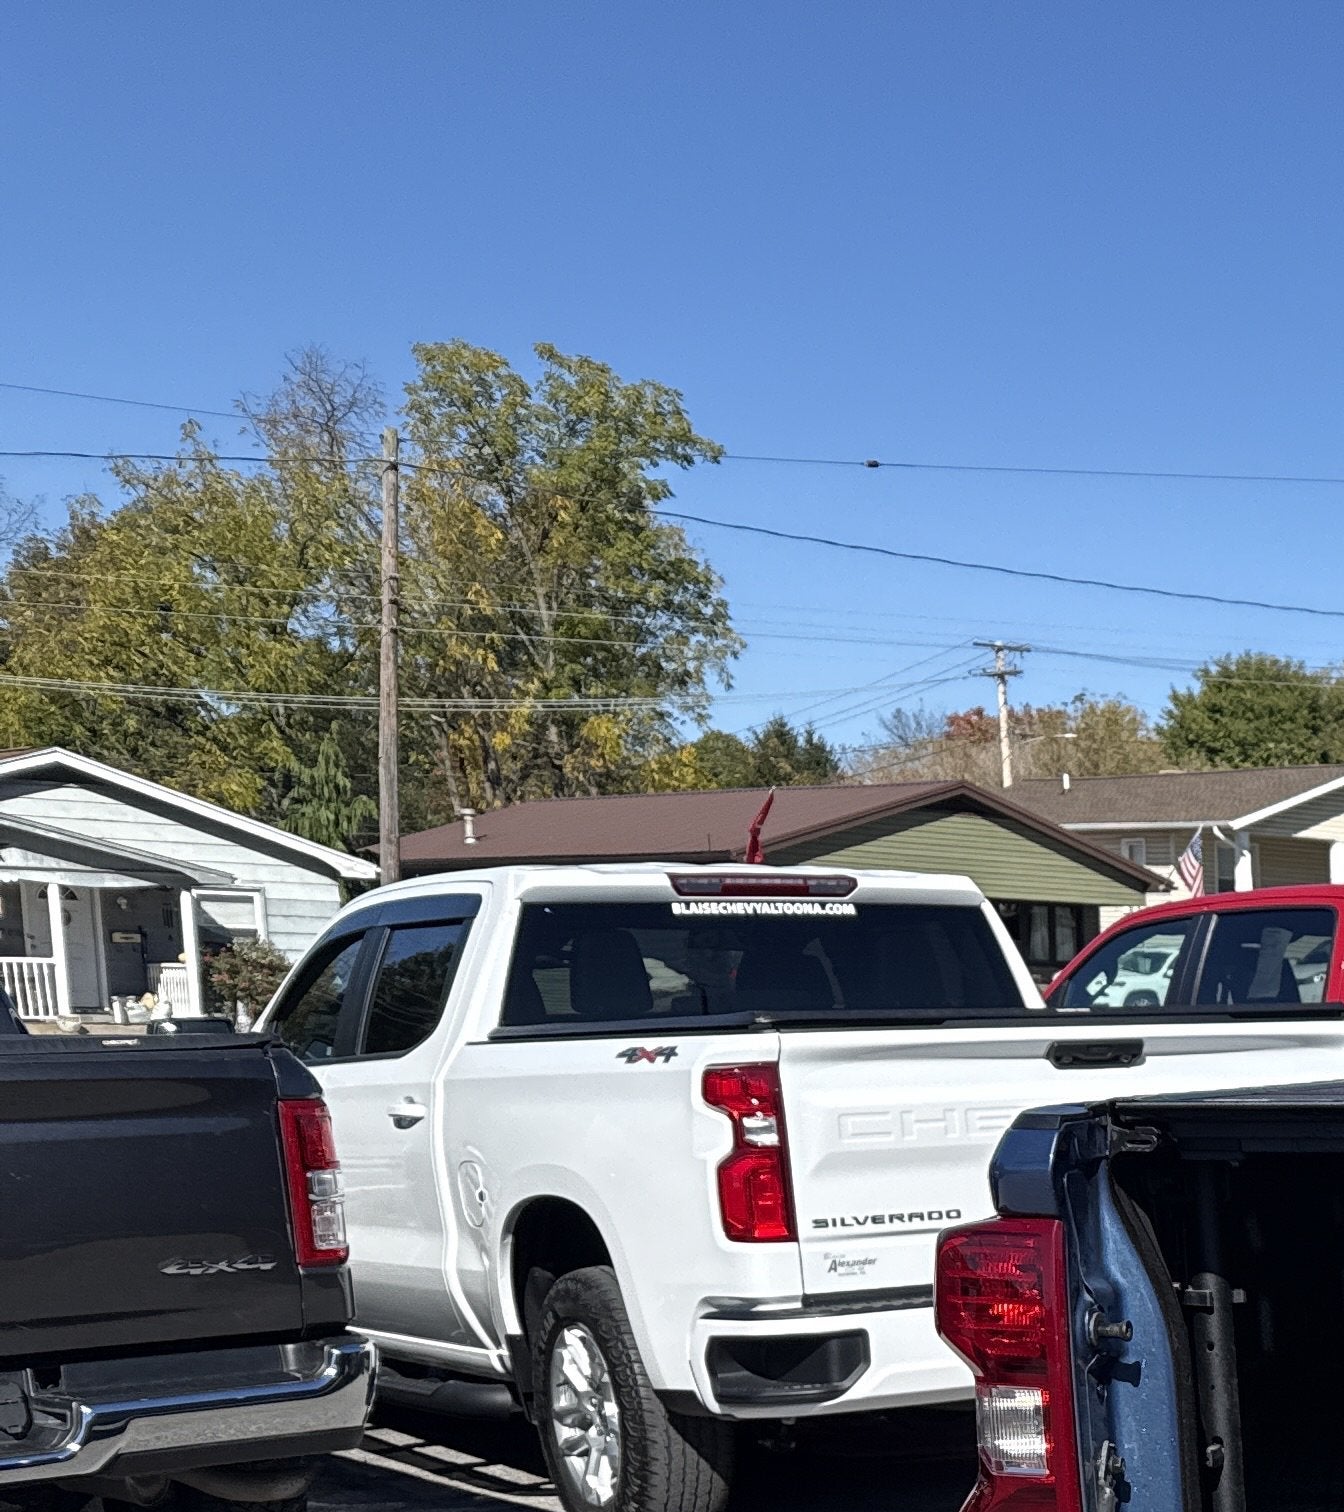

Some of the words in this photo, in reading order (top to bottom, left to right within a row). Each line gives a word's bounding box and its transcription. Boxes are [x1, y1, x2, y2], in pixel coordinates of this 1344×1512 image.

[671, 902, 857, 915] BLAISECHEVYALTOONA.COM
[812, 1208, 962, 1229] SILVERADO
[827, 1257, 878, 1273] Alexander
